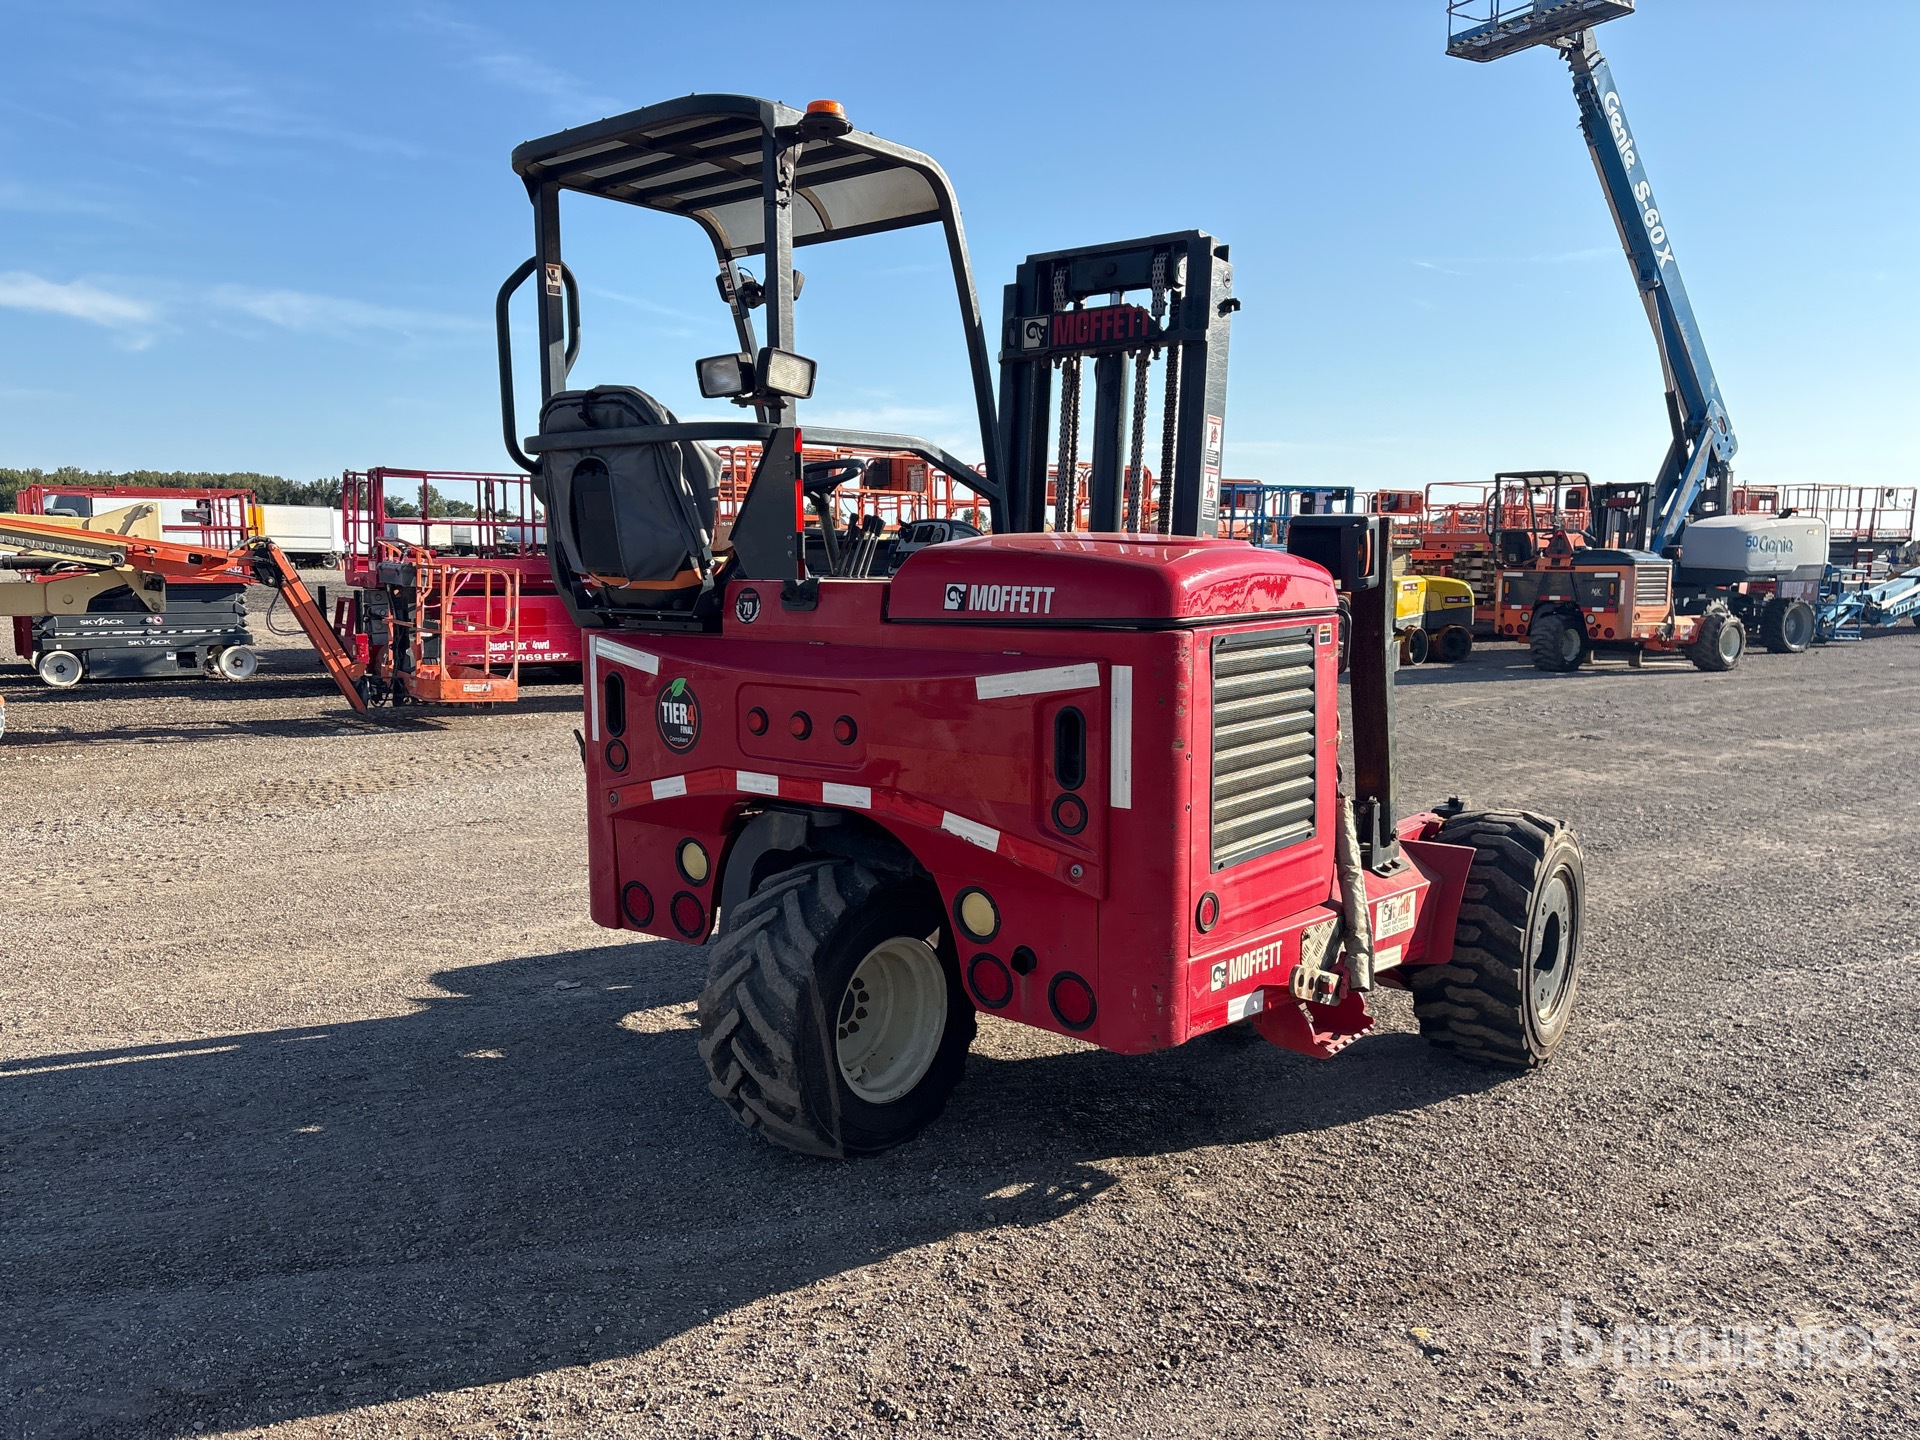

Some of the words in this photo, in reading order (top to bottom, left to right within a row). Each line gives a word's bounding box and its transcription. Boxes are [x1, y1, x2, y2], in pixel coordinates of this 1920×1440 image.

[1605, 91, 1636, 171] Genie
[1052, 306, 1148, 346] MOFFETT
[1745, 535, 1758, 548] 50
[1759, 535, 1793, 553] Genie
[968, 584, 1056, 614] MOFFETT
[79, 617, 125, 626] SKYJACK
[680, 725, 693, 735] FINAL
[1228, 939, 1283, 985] MOFFETT
